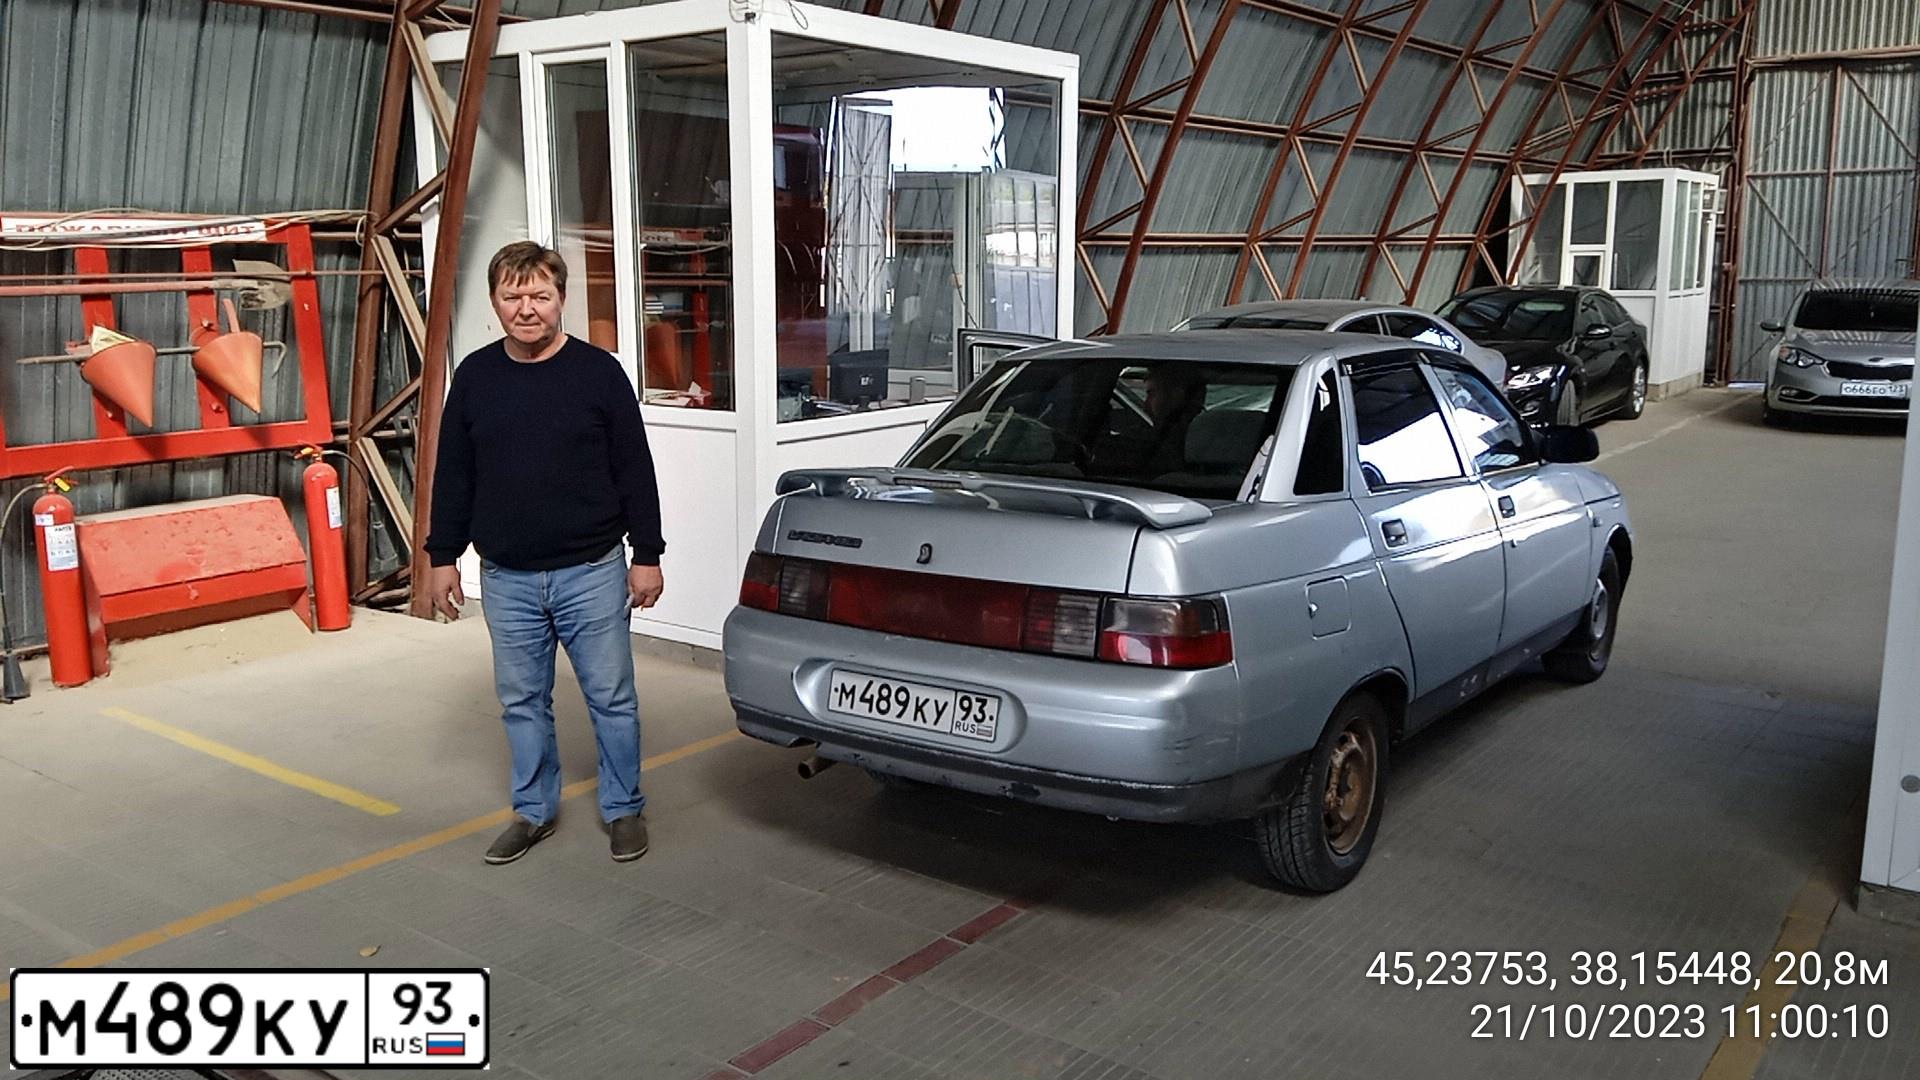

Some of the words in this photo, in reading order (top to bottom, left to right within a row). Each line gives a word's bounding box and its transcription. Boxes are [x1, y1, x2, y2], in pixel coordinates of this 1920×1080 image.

[838, 680, 948, 726] М489КУ
[959, 695, 989, 723] 93
[955, 722, 976, 734] RUS
